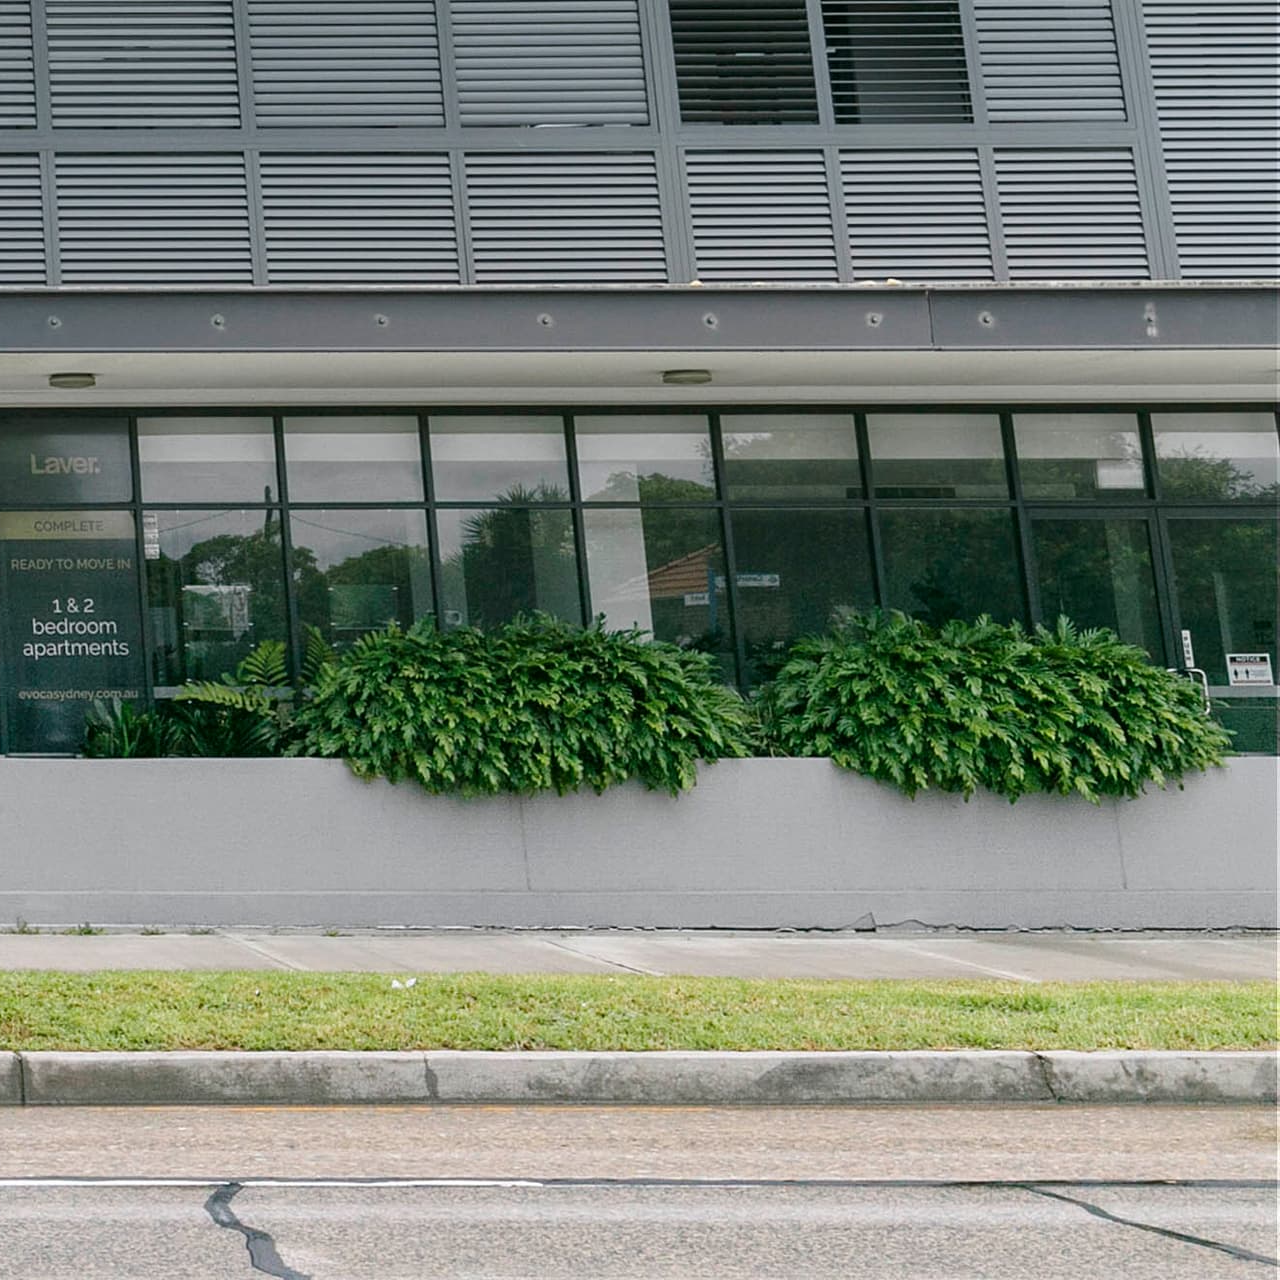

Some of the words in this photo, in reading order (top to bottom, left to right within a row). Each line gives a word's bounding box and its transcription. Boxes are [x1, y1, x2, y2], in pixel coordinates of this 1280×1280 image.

[30, 453, 101, 475] Laver.
[33, 520, 105, 533] COMPLETE
[10, 558, 54, 570] READY
[56, 558, 73, 570] TO
[76, 558, 114, 570] MOVE
[116, 558, 131, 569] IN
[52, 599, 62, 613] 1
[67, 597, 80, 613] &
[83, 598, 95, 613] 2
[32, 617, 118, 635] bedroom
[23, 639, 130, 660] apartments
[18, 688, 139, 701] evocasydney.com.au
